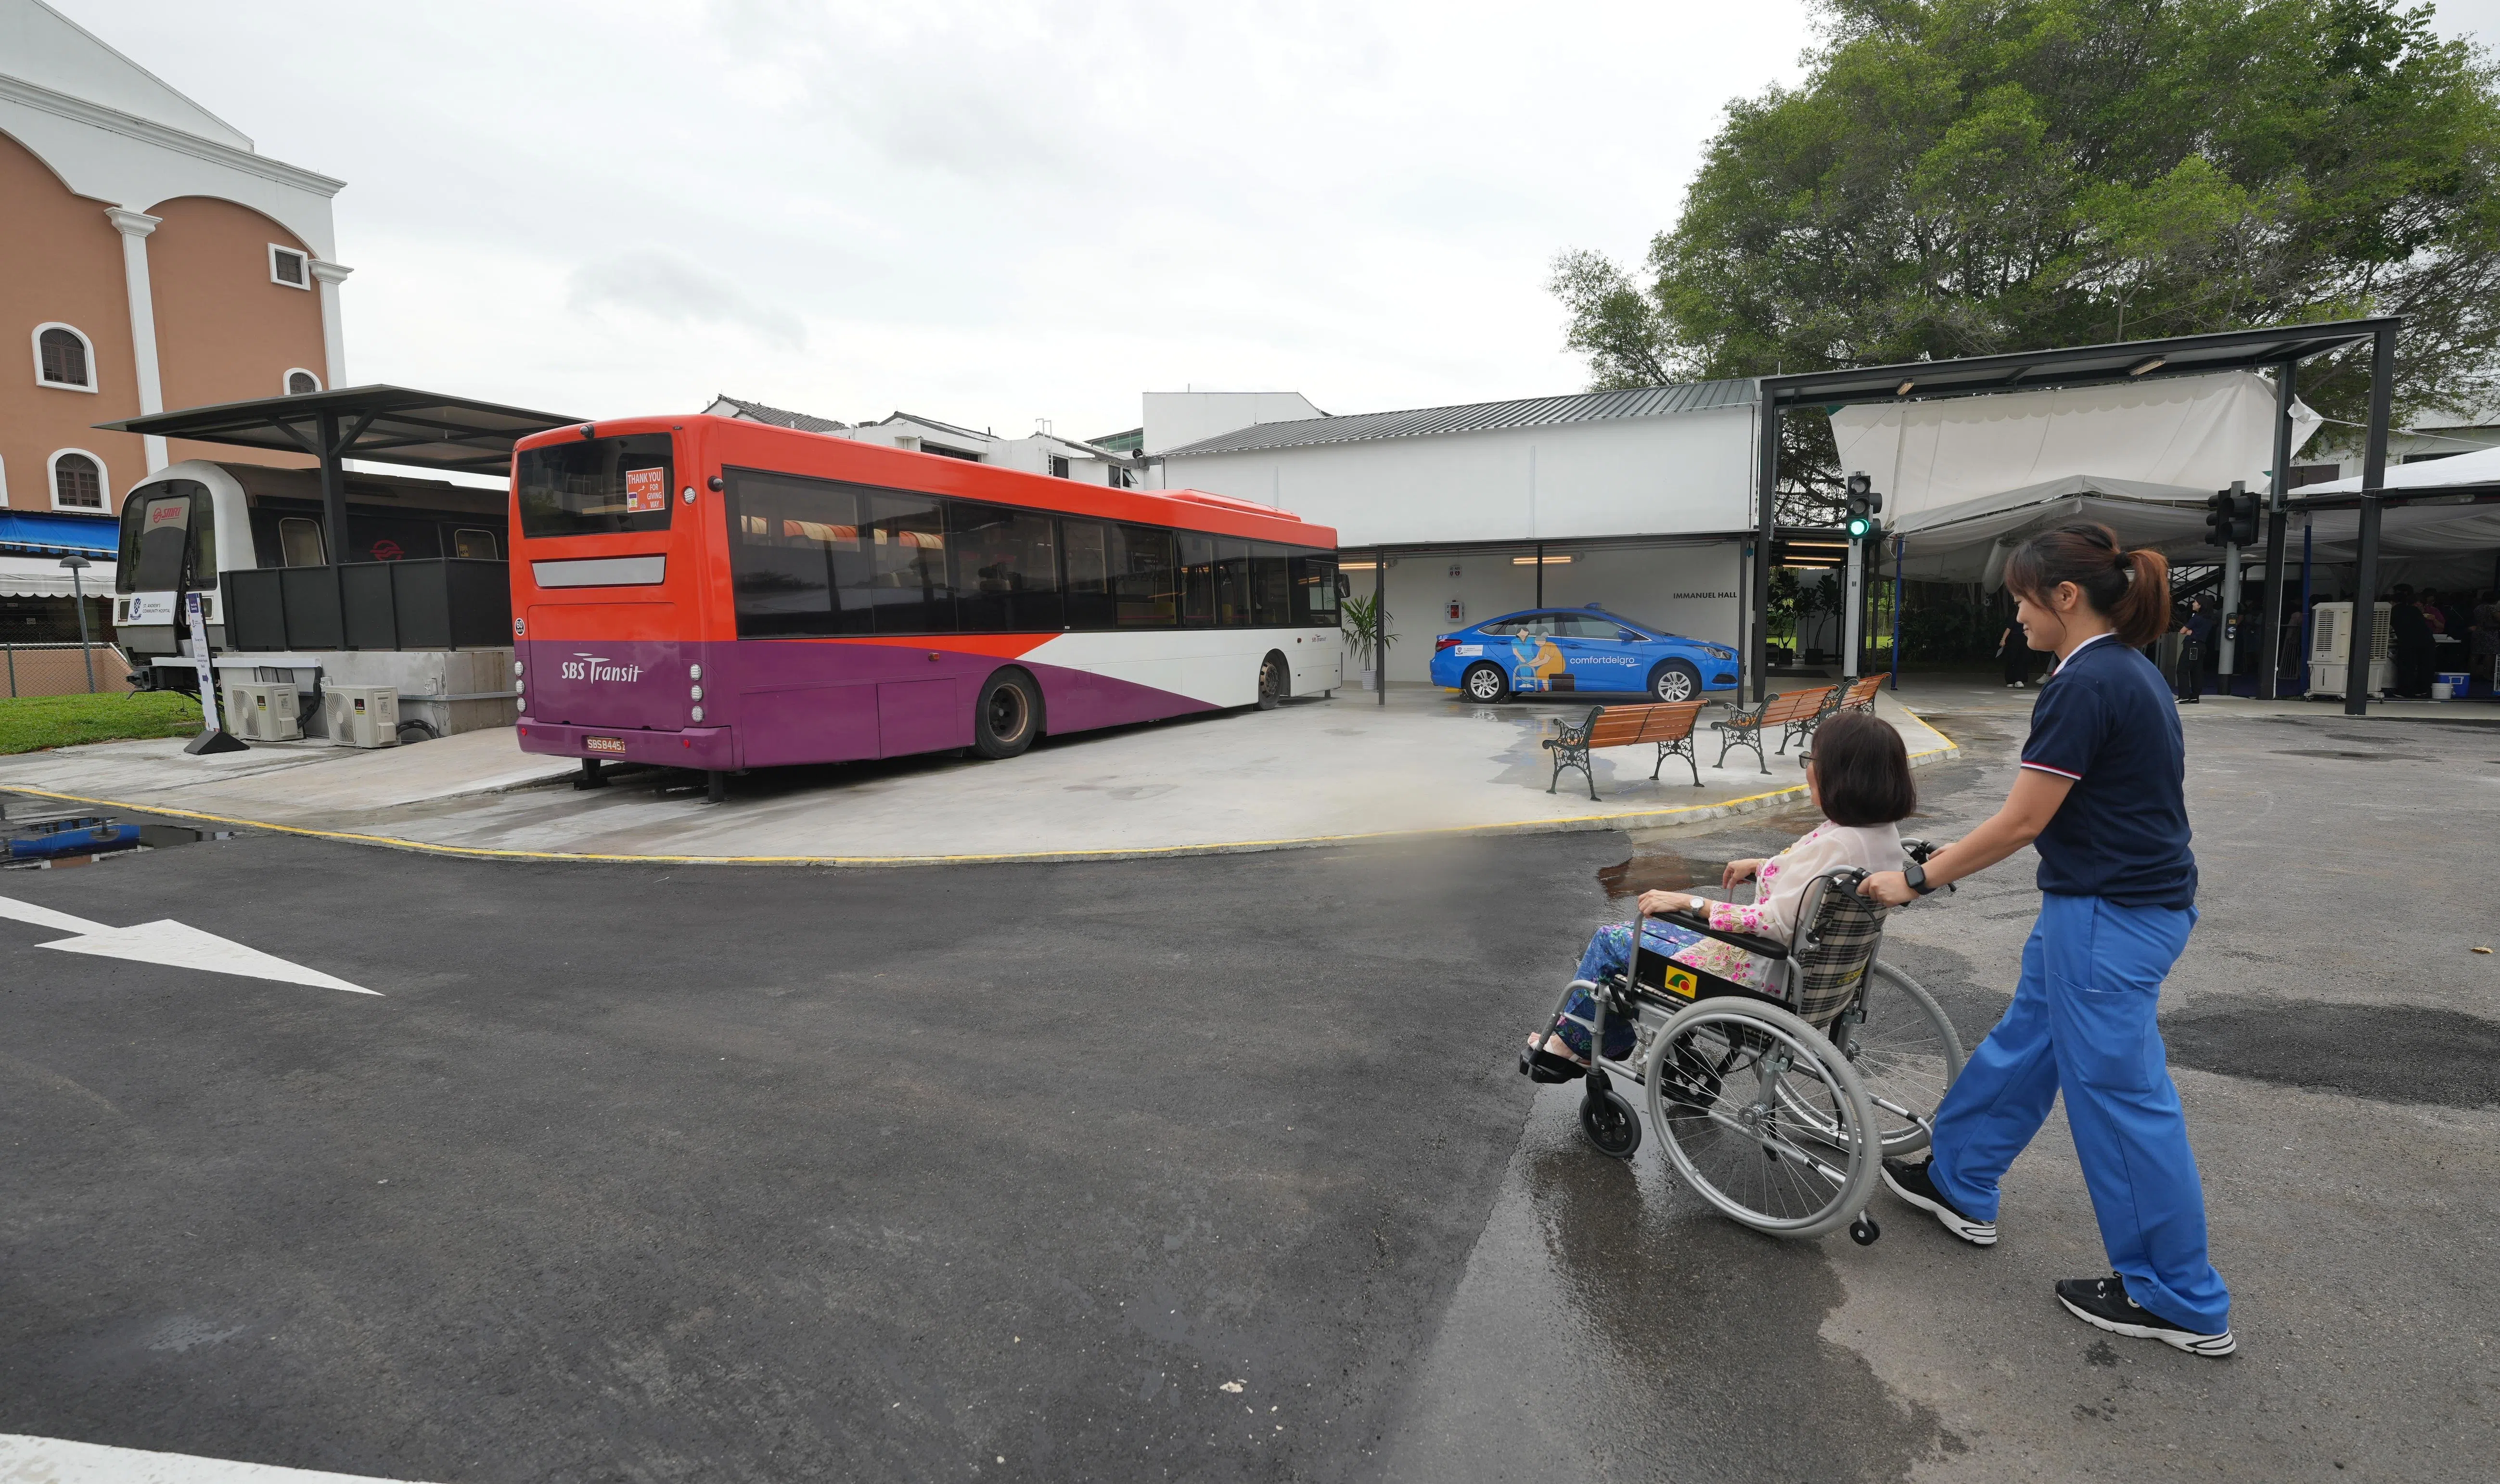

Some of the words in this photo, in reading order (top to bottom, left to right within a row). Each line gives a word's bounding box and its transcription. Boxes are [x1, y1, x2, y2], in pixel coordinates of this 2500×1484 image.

[628, 473, 648, 485] THANK
[648, 471, 661, 482] YOU
[650, 483, 659, 491] FOR
[647, 492, 662, 500] GIVING
[161, 507, 182, 518] SMRT
[516, 620, 523, 628] 60
[1570, 656, 1635, 665] comfortdelgro
[562, 662, 585, 680] SBS
[582, 657, 644, 684] Transit
